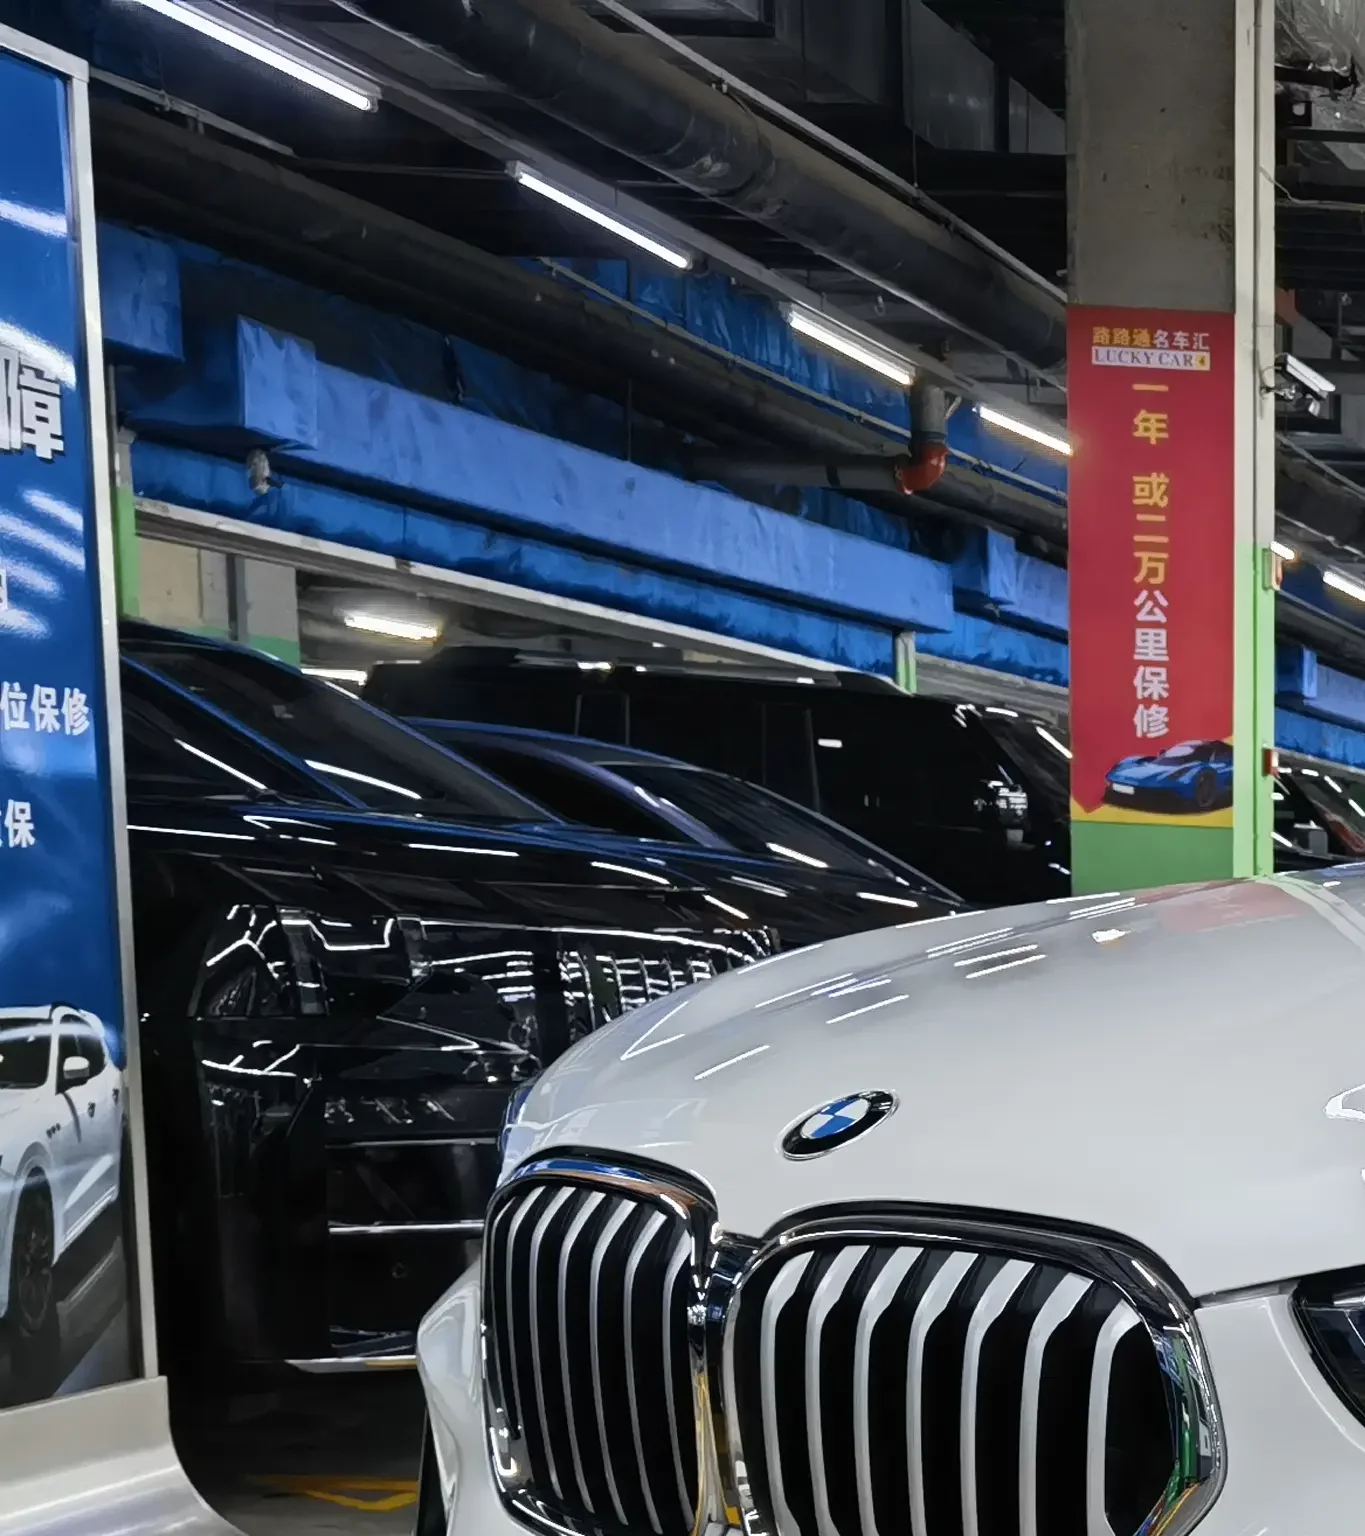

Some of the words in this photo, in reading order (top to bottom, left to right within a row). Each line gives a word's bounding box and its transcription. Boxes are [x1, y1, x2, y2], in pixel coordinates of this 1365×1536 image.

[1092, 326, 1210, 351] 路路通名车汇
[1094, 348, 1154, 365] LUCKY
[1158, 352, 1194, 368] CAR
[0, 681, 90, 736] 位保修
[0, 799, 36, 848] 保
